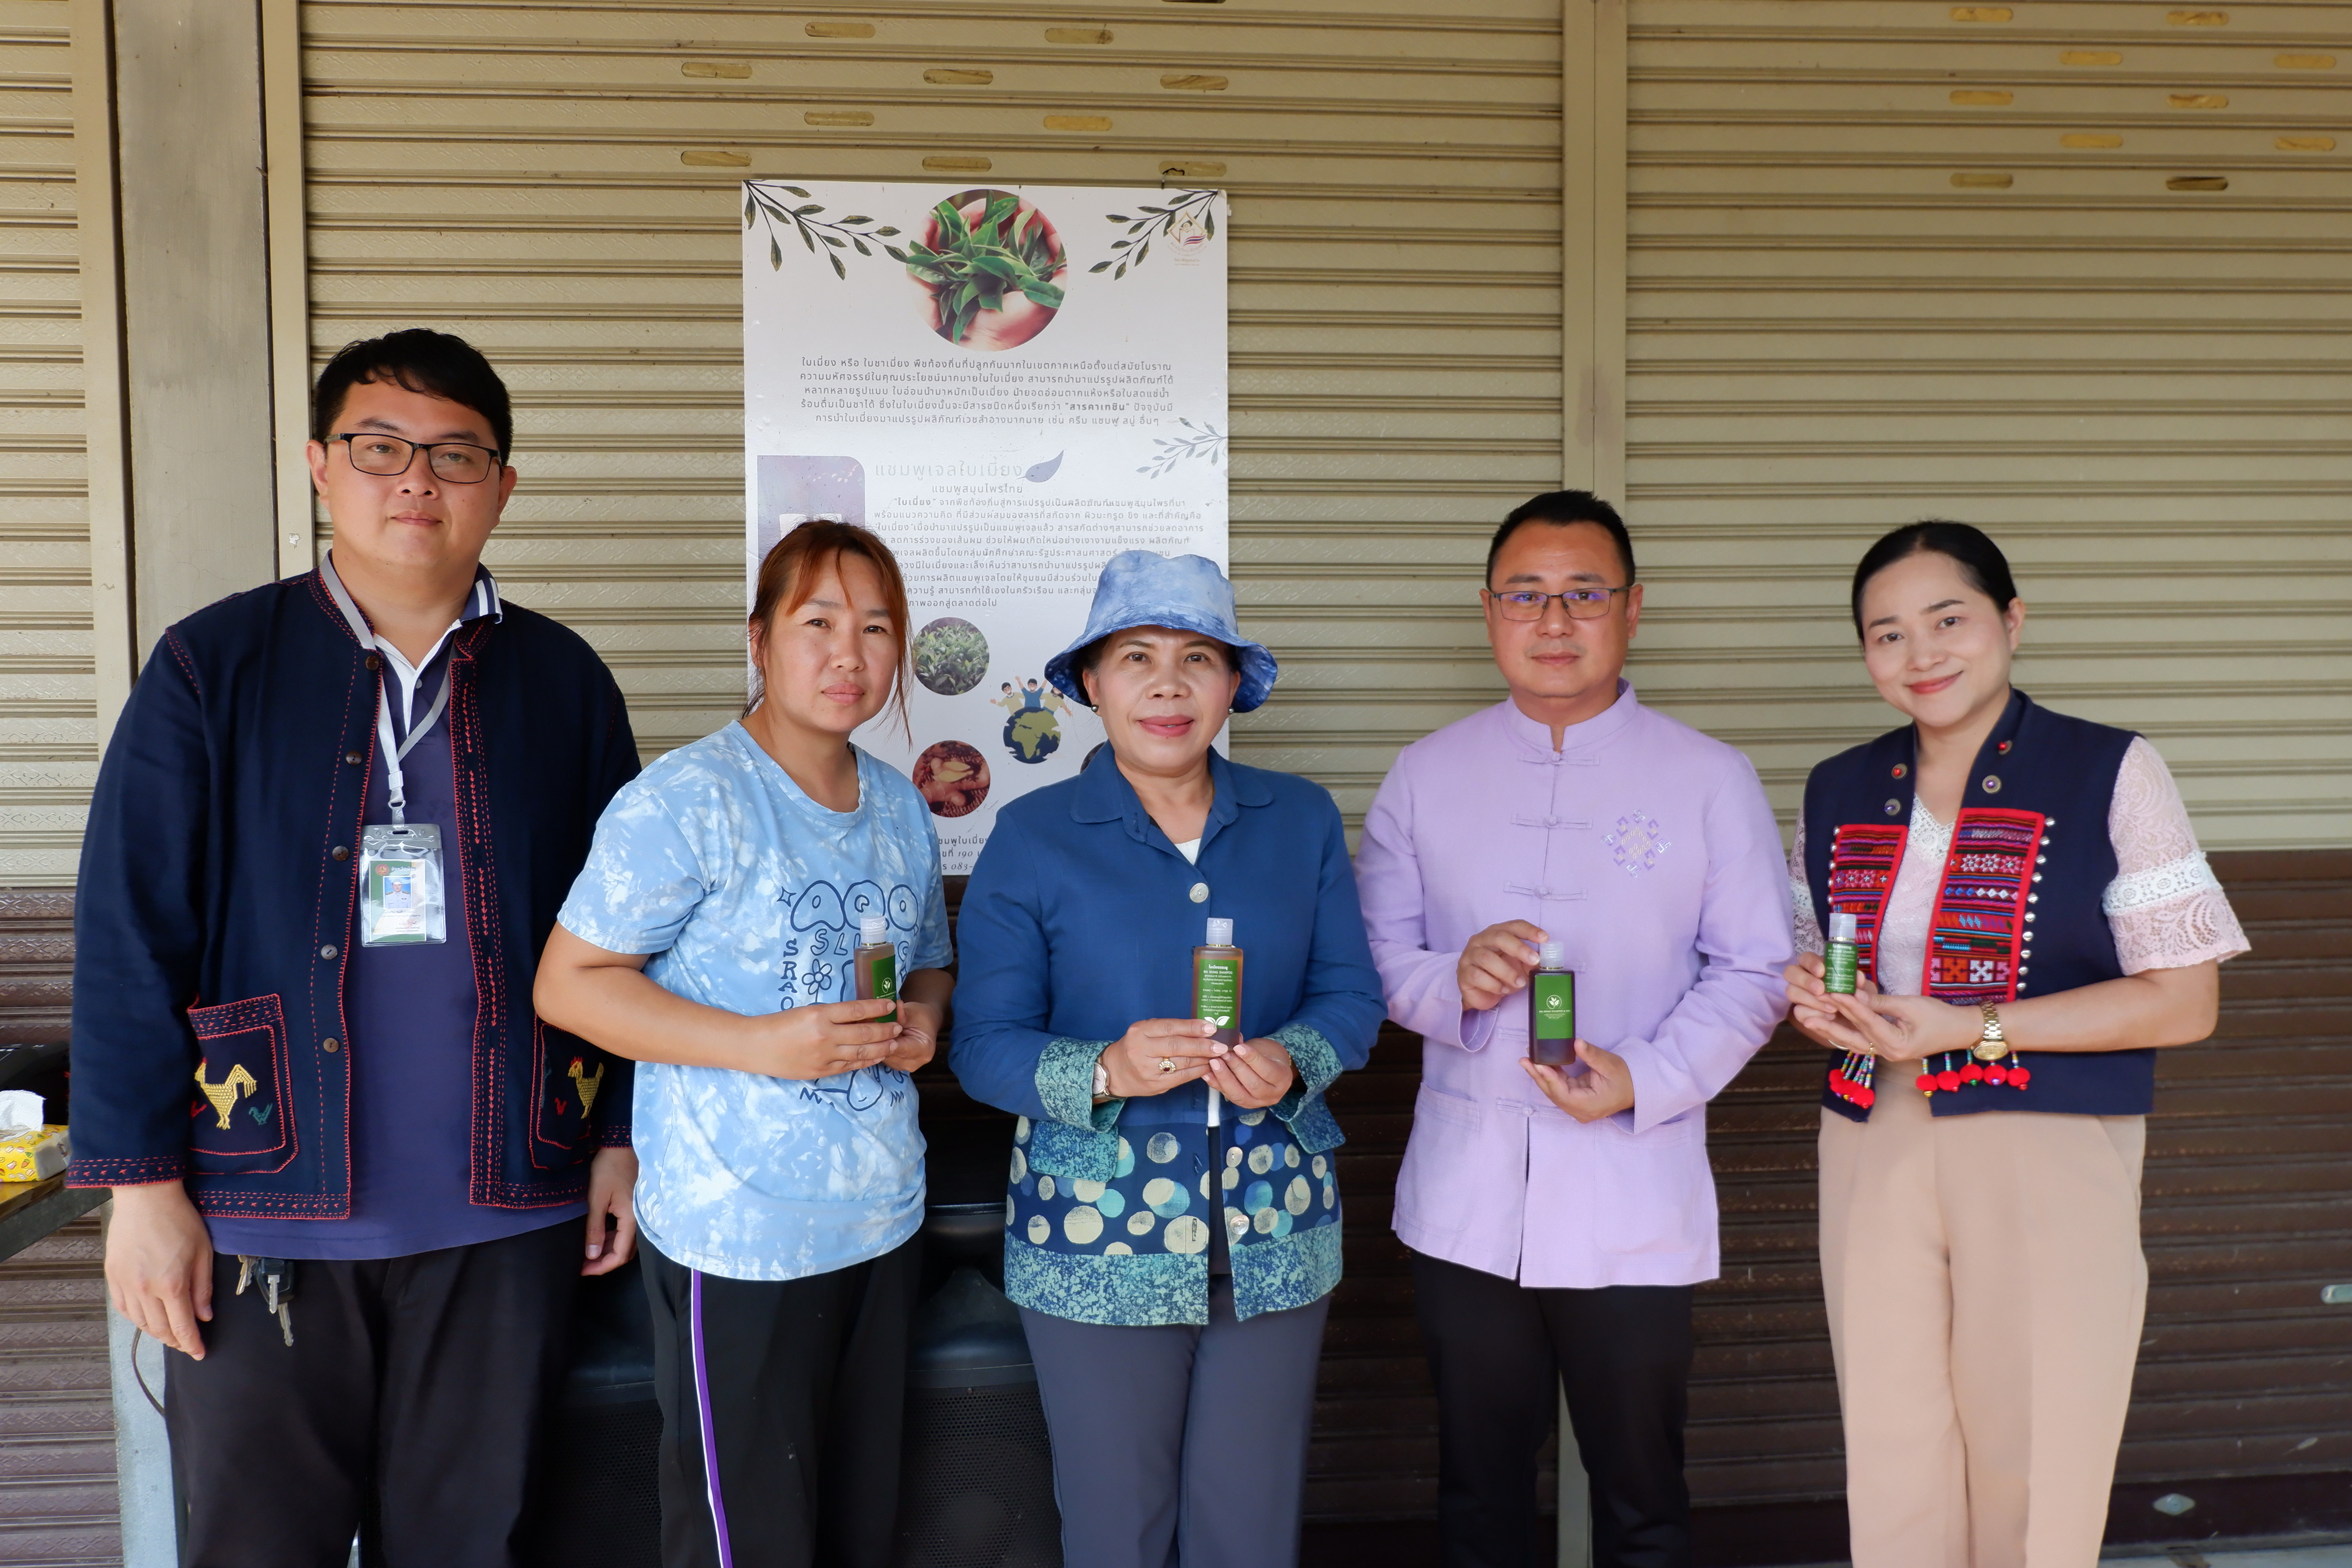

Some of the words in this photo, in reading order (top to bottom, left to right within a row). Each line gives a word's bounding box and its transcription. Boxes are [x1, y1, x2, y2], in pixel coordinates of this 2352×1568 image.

[802, 355, 837, 367] ใบเมี่ยง
[841, 358, 859, 367] หรือ
[1048, 412, 1064, 424] เช่น
[1069, 415, 1087, 424] ครีม
[1092, 417, 1120, 427] แชมพู
[1122, 415, 1135, 427] สบู่
[1140, 414, 1159, 426] อื่นๆ
